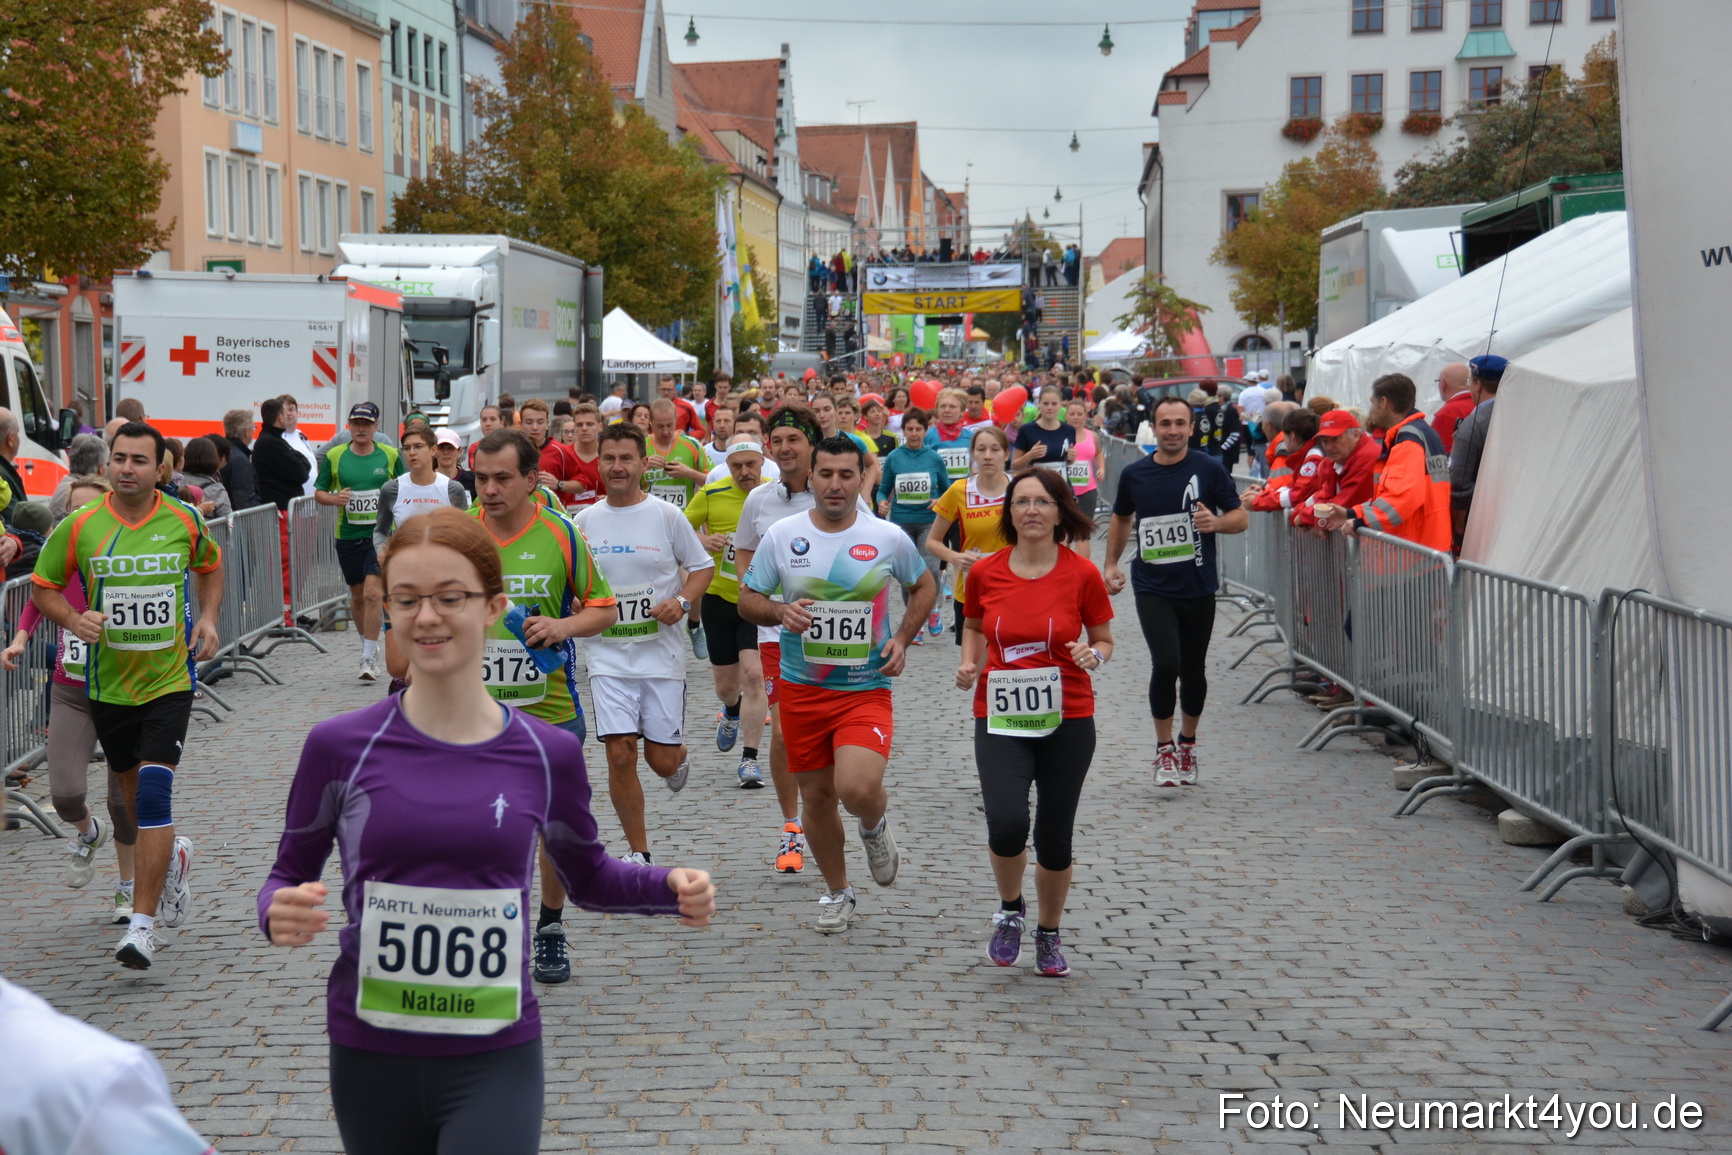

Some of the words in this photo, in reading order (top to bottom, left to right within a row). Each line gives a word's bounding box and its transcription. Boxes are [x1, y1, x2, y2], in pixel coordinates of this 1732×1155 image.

[913, 296, 968, 310] START
[216, 336, 290, 349] Bayerisches
[216, 352, 251, 363] Rotes
[607, 359, 656, 370] Laufsport
[216, 367, 251, 378] Kreuz
[1067, 466, 1088, 476] 5024
[900, 480, 928, 493] 5028
[349, 499, 378, 512] 5023
[654, 493, 684, 507] 179
[966, 510, 992, 519] MAX
[1145, 525, 1188, 547] 5149
[853, 548, 875, 557] Hervis
[1157, 549, 1178, 557] Katrin
[90, 553, 181, 578] BOCK
[105, 591, 130, 600] PARTL
[130, 591, 165, 599] Neumarkt
[615, 590, 646, 599] Neumarkt
[112, 600, 171, 627] 5163
[615, 598, 652, 622] 178
[804, 606, 827, 614] PARTL
[610, 625, 648, 636] Wolfgang
[810, 616, 867, 641] 5164
[122, 632, 161, 642] Sleiman
[826, 646, 848, 656] Azad
[482, 657, 540, 682] 5173
[1012, 676, 1047, 684] Neumarkt
[497, 688, 518, 698] Tino
[995, 685, 1053, 712] 5101
[1006, 718, 1046, 728] Susanne
[368, 897, 418, 915] PARTL
[423, 903, 497, 918] Neumarkt
[378, 921, 507, 978] 5068
[402, 989, 475, 1014] Natalie
